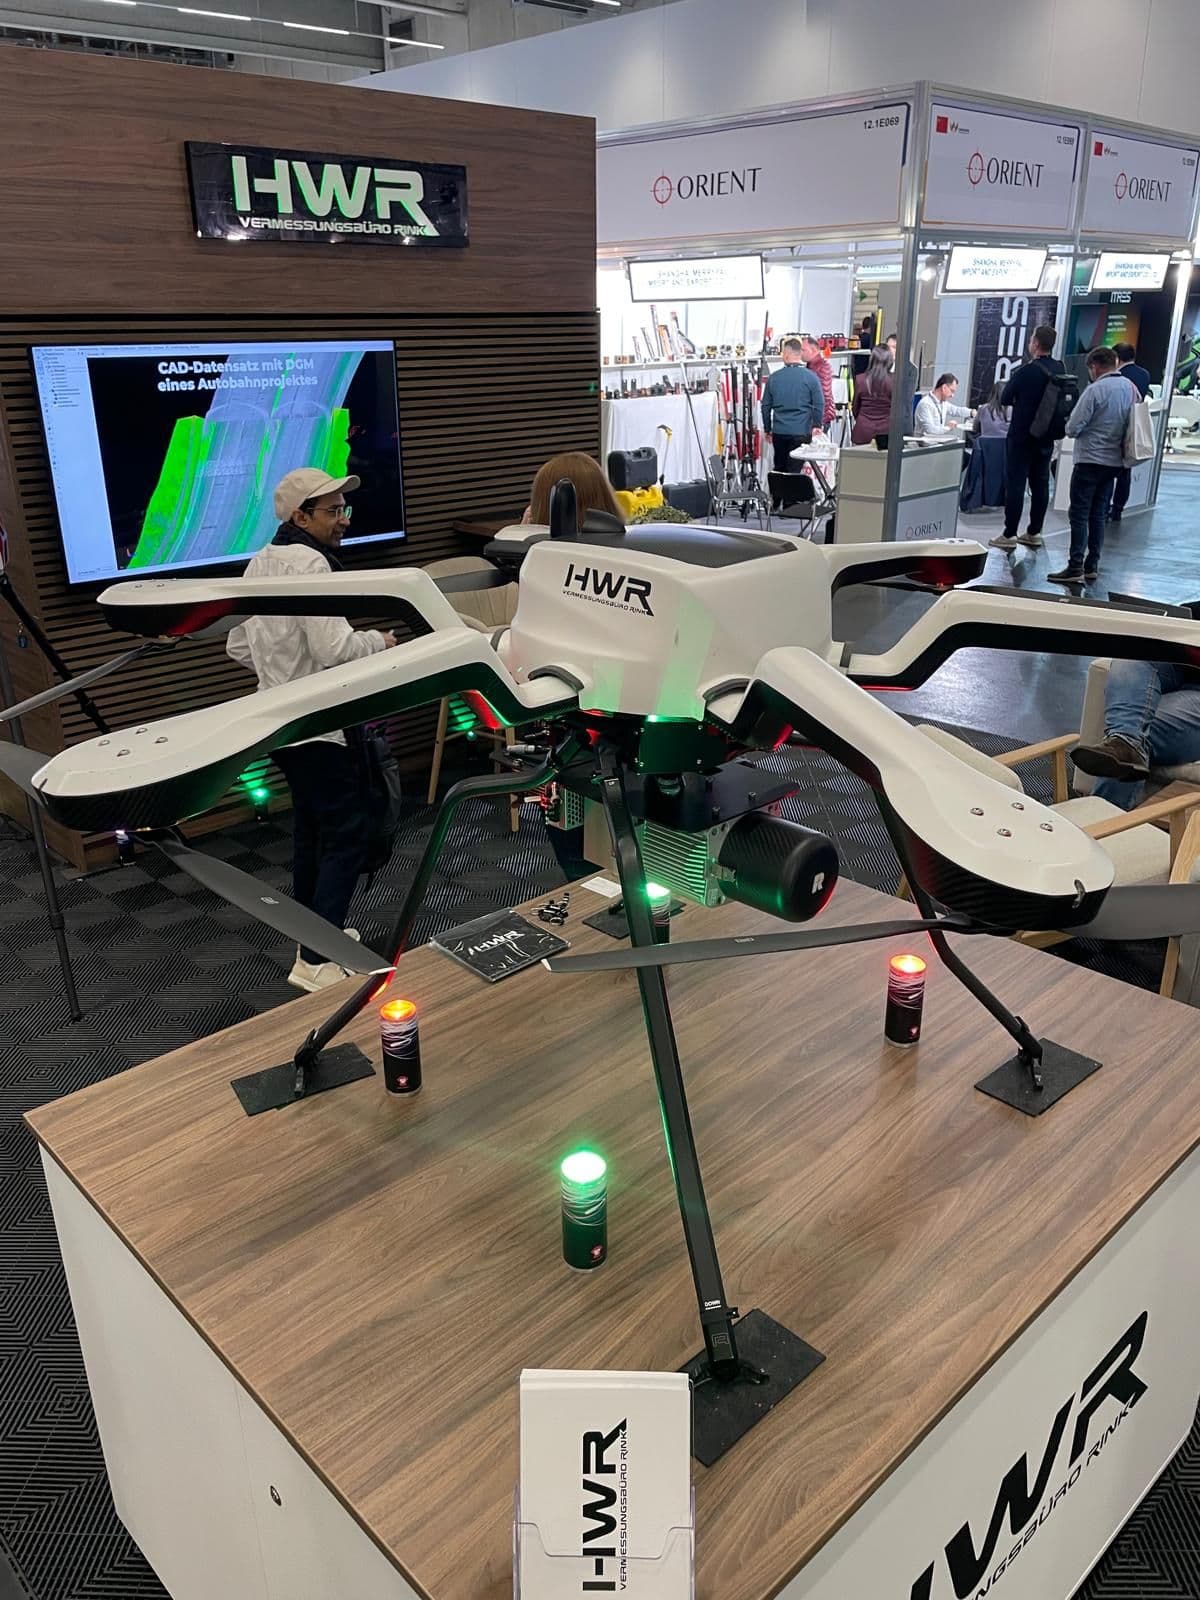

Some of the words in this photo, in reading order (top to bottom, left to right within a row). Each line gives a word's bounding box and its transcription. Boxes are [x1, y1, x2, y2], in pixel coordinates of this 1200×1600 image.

[863, 116, 900, 130] 12.1E069
[677, 167, 762, 200] ORIENT
[986, 157, 1045, 188] ORIENT
[231, 155, 440, 237] HWR
[1128, 176, 1173, 202] ORIENT
[239, 216, 392, 235] VERMESSUNGSBÜRO
[393, 224, 426, 236] RINK
[158, 358, 259, 374] CAD-Datensatz
[261, 356, 283, 370] mit
[285, 358, 314, 370] DGM
[157, 378, 195, 391] eines
[197, 375, 318, 391] Autobahnprojektes
[914, 520, 943, 537] ORIENT
[564, 564, 654, 617] HWR
[620, 1429, 628, 1460] RINK
[1086, 1392, 1136, 1466] RINK
[583, 1418, 627, 1591] HWR
